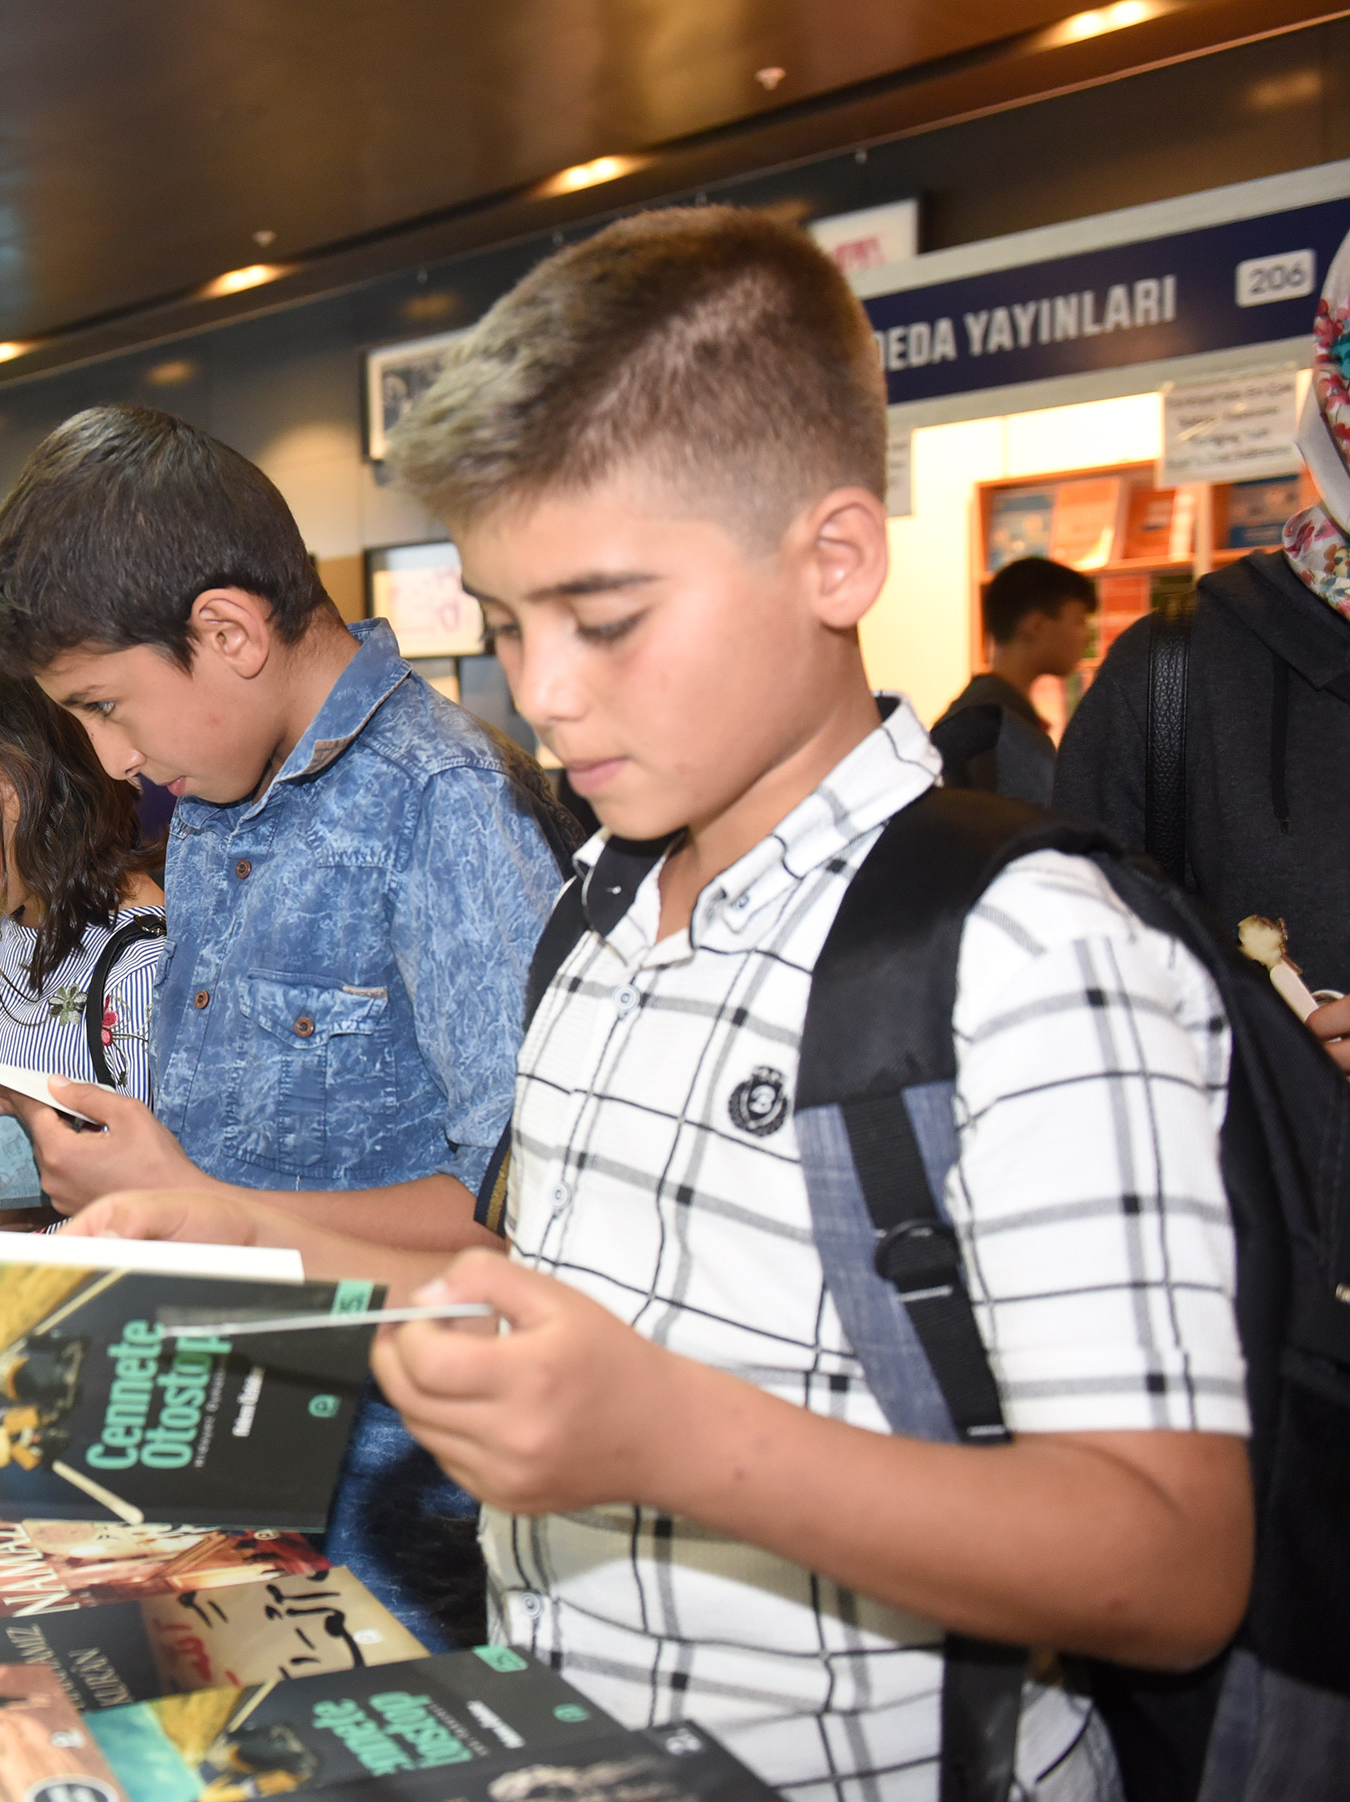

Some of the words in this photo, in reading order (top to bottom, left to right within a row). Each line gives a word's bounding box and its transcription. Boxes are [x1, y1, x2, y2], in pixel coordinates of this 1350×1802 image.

[962, 273, 1177, 357] YAYINLARI
[1250, 265, 1305, 295] 206
[85, 1319, 165, 1470] Cennete
